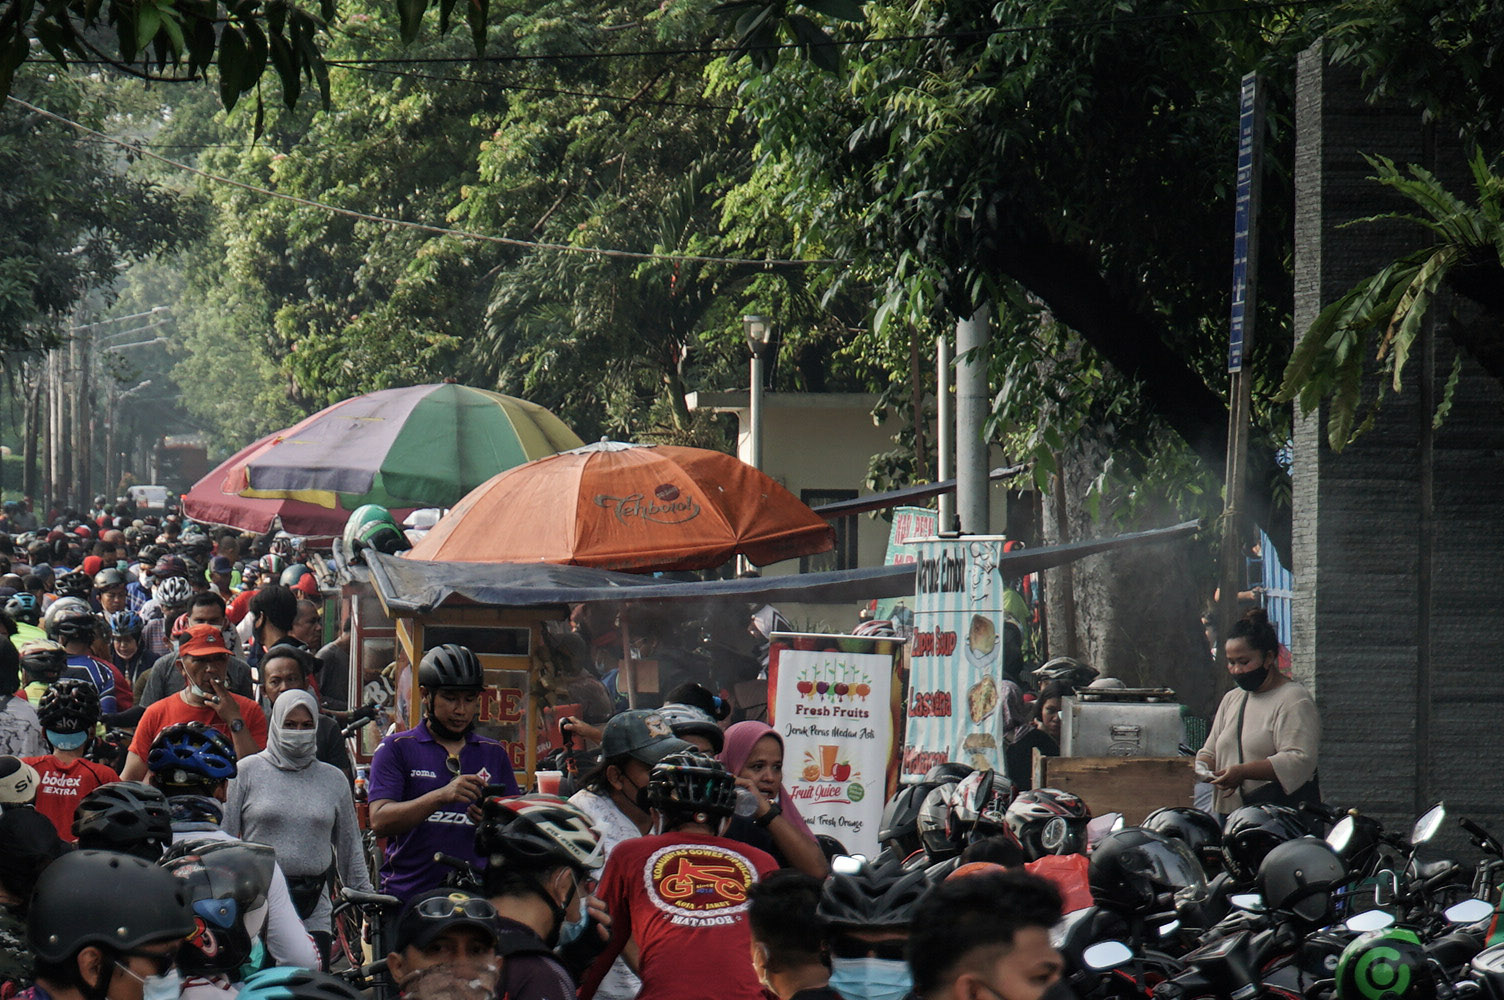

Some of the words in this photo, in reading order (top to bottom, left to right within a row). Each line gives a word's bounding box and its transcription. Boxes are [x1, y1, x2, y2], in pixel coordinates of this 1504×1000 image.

[795, 704, 831, 717] Fresh
[832, 707, 870, 719] Fruits
[55, 716, 78, 730] sky
[41, 770, 82, 788] bodrex
[790, 784, 815, 800] Fruit
[814, 783, 842, 802] Juice
[669, 914, 736, 928] MATADOR
